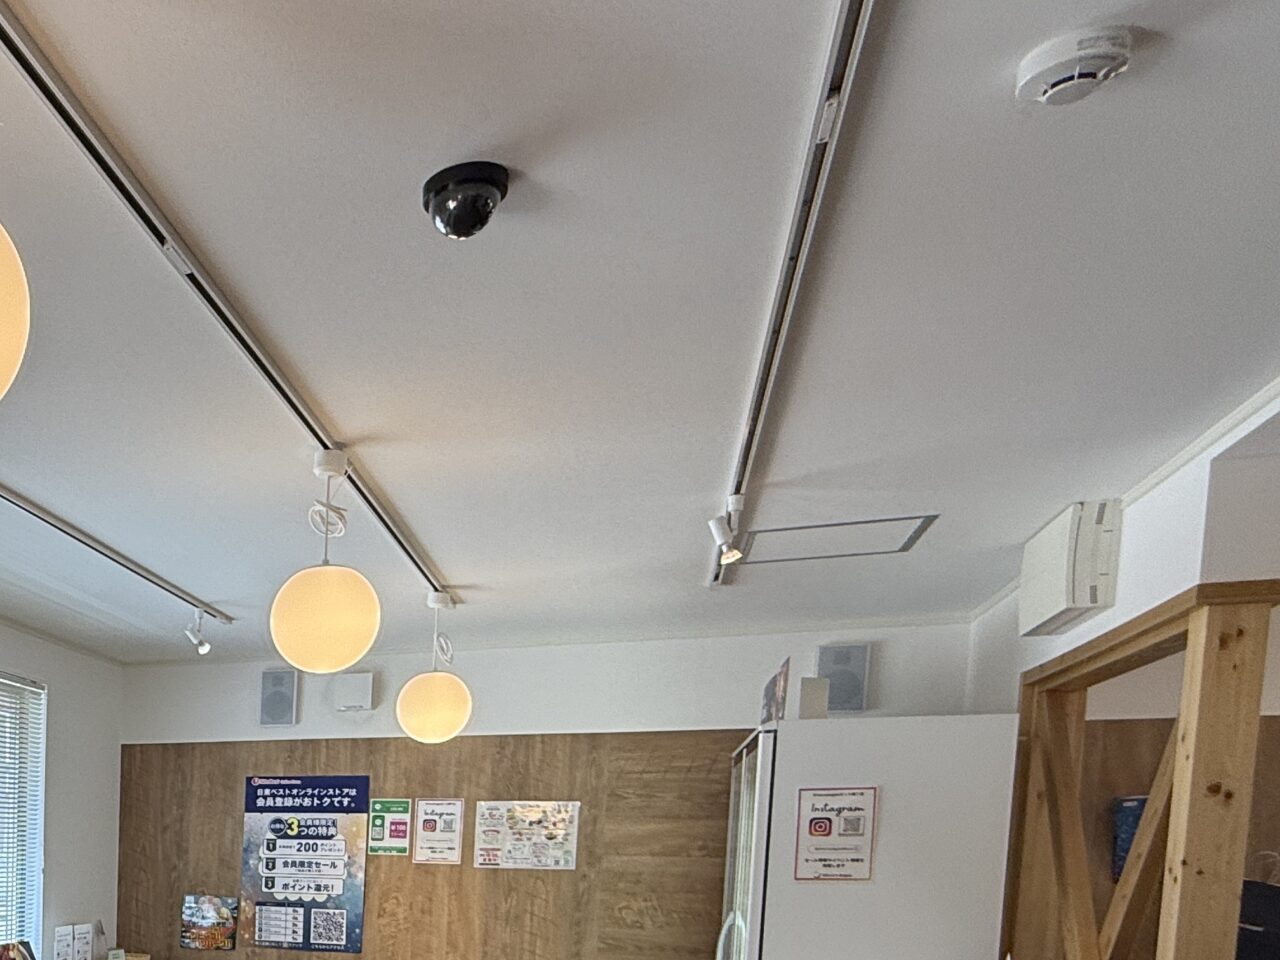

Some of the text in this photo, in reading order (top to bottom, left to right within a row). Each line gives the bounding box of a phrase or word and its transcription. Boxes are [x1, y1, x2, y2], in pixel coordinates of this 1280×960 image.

[257, 788, 357, 796] 日東ベストオンラインストアは
[256, 797, 355, 807] 会員登録がおトクです。
[811, 803, 865, 817] Instagram
[296, 842, 319, 853] 200
[282, 861, 338, 870] 会員限定セール
